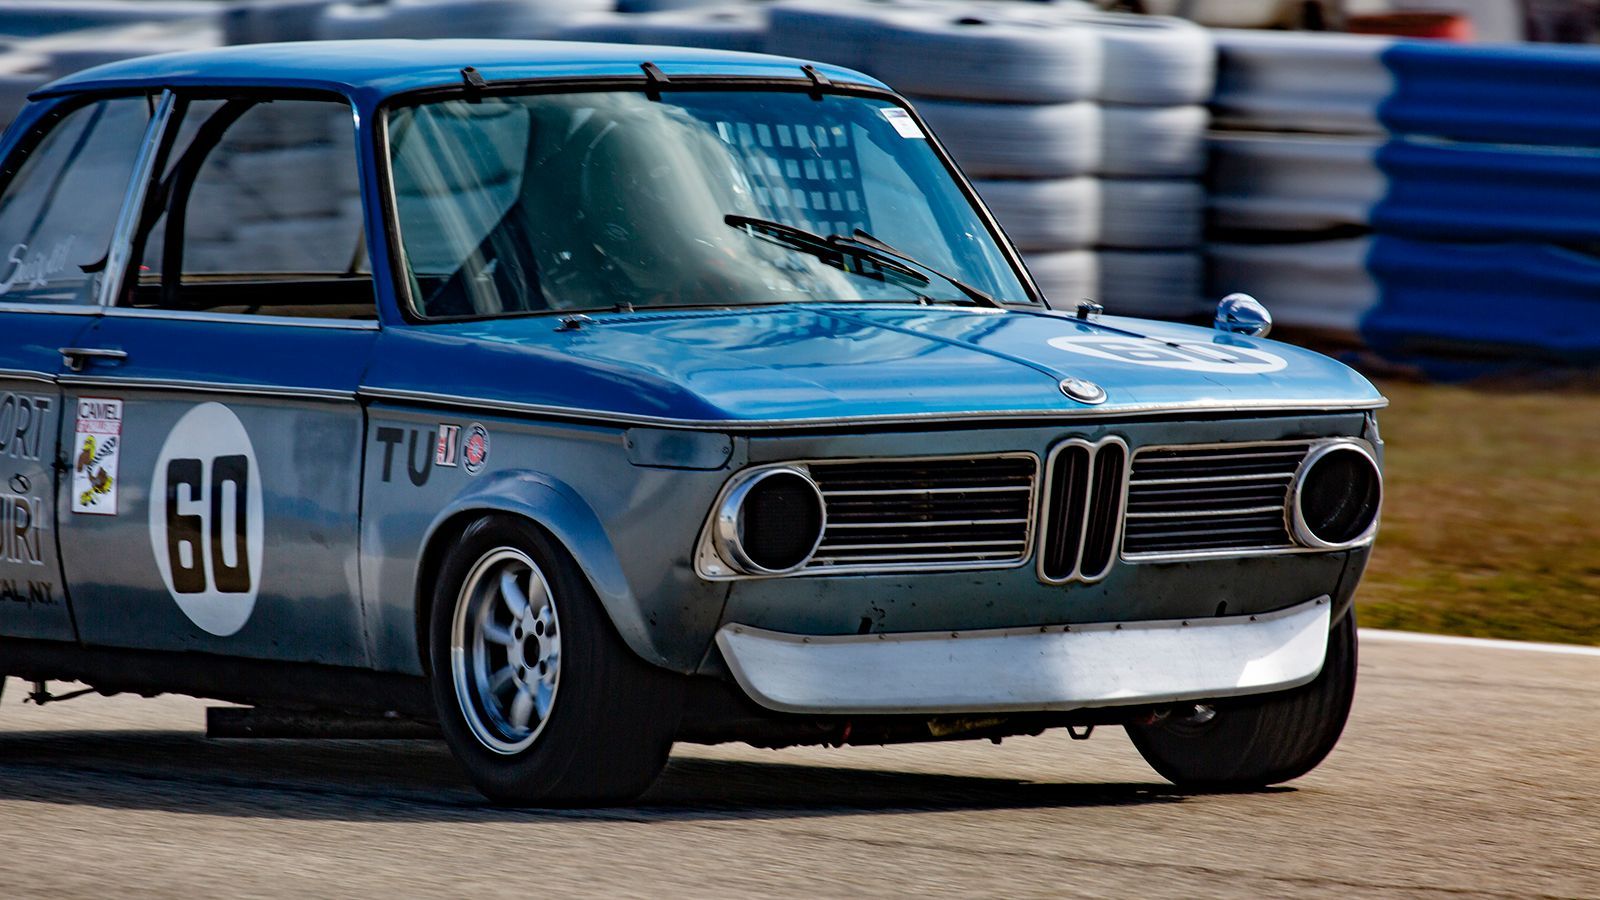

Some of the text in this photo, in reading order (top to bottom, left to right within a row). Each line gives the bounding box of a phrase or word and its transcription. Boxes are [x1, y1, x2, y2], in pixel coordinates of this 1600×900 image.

[79, 402, 120, 420] CAMEL
[376, 426, 436, 487] TU
[166, 454, 251, 594] 60
